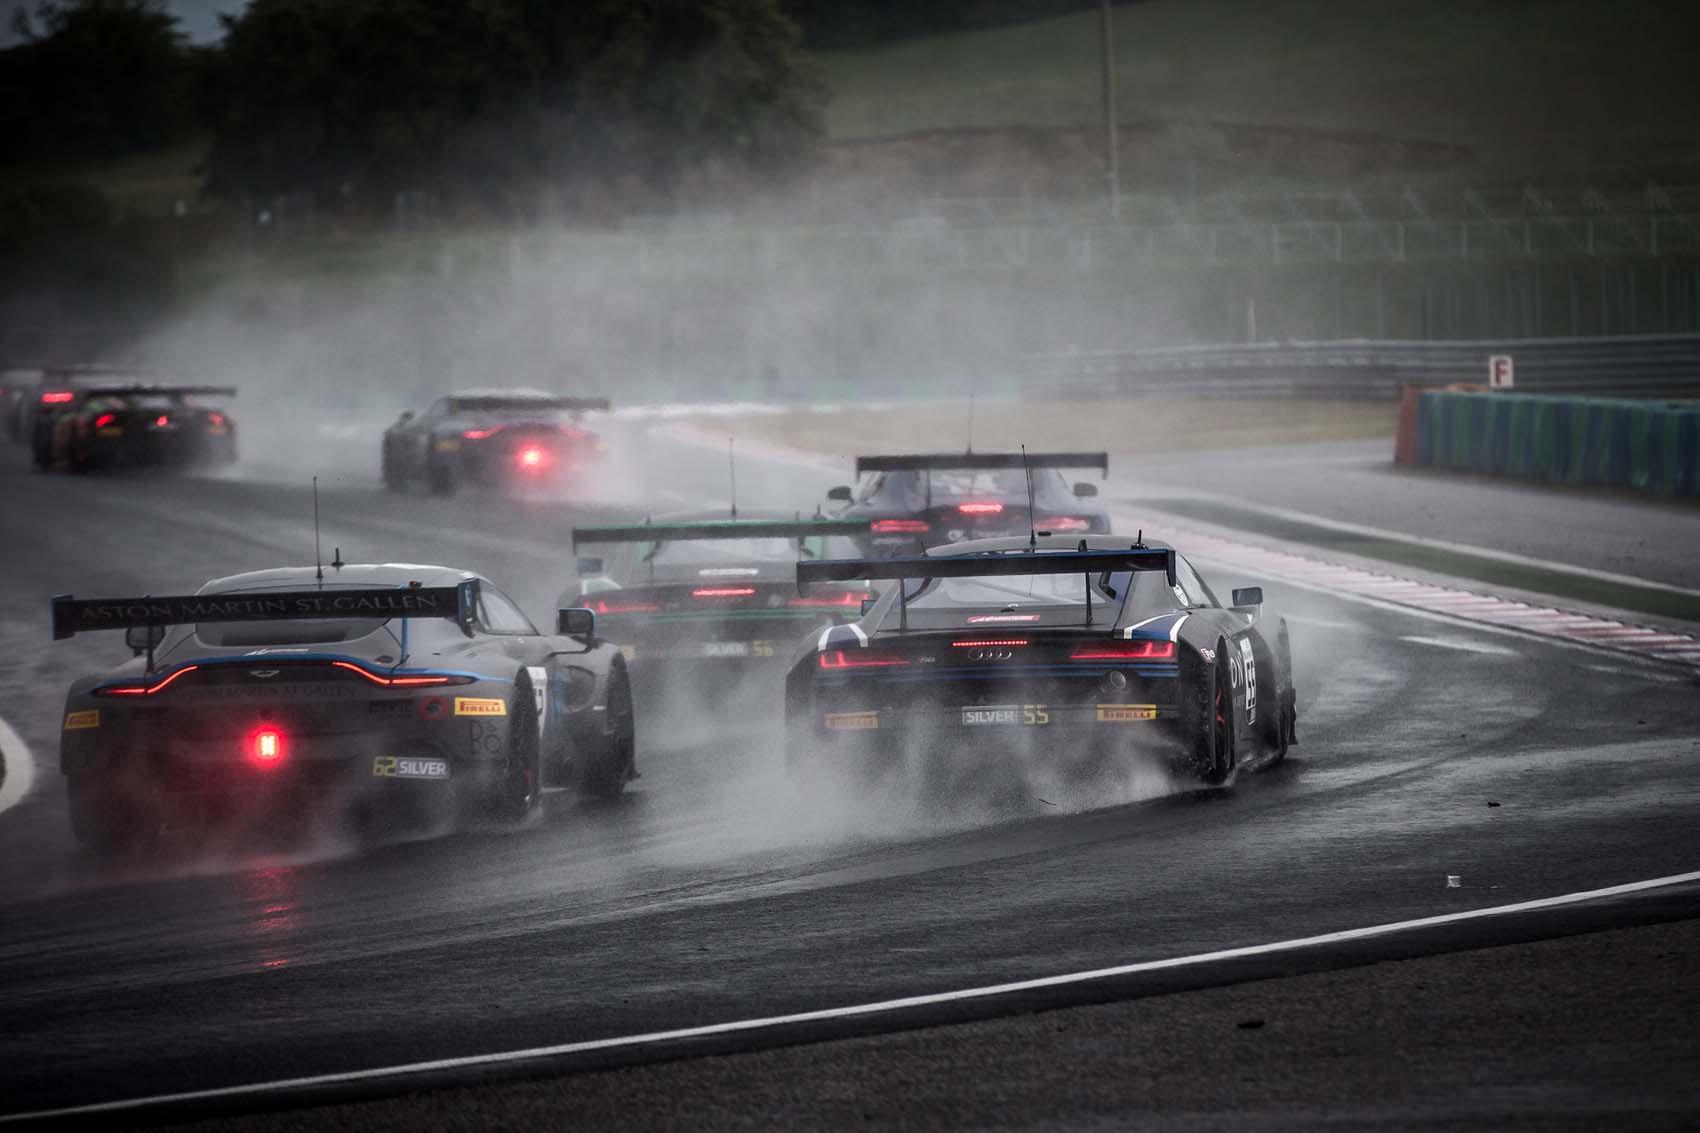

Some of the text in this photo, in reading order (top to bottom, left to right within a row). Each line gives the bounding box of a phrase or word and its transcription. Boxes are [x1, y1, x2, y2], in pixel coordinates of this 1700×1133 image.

[1495, 359, 1510, 384] F
[81, 605, 174, 620] ASTON
[180, 599, 287, 617] MARTIN
[459, 701, 501, 713] PIRELLI
[965, 704, 1049, 725] SILVER 55
[372, 755, 447, 777] 62 SILVER
